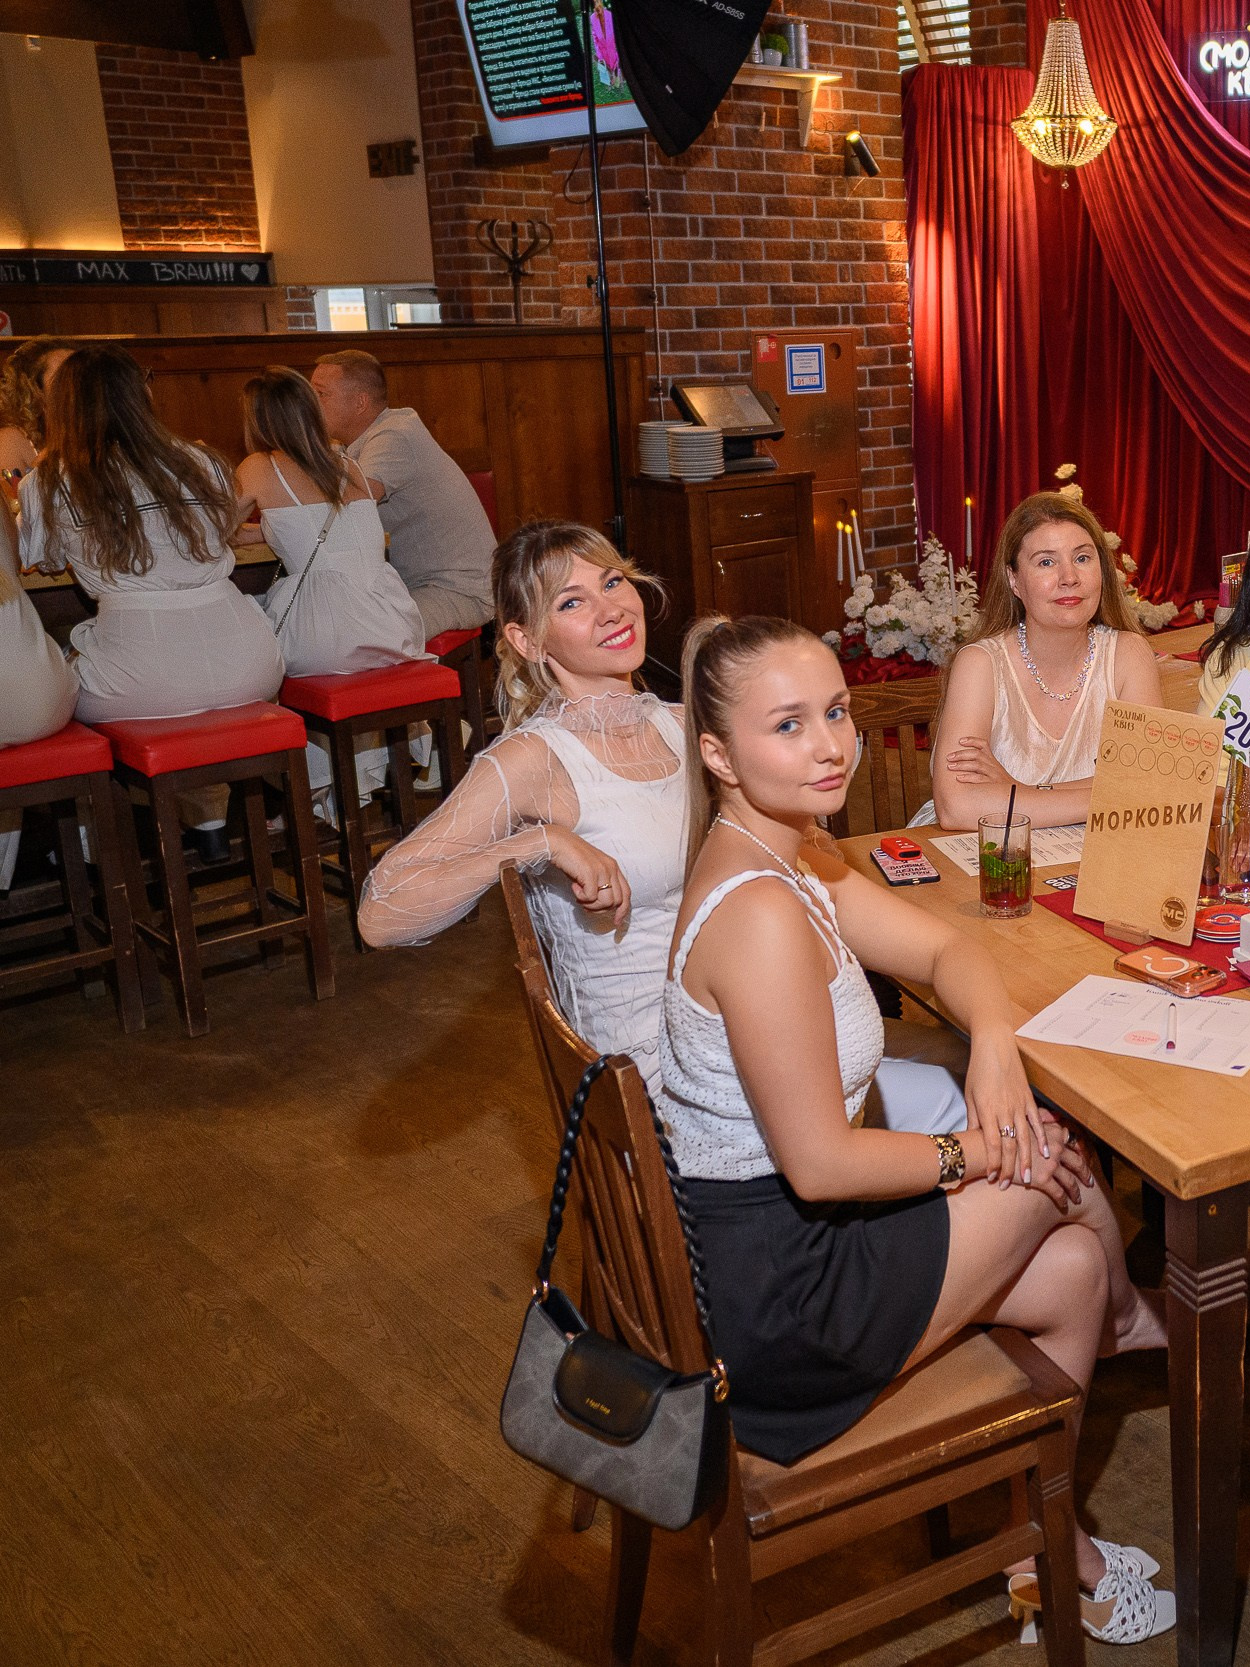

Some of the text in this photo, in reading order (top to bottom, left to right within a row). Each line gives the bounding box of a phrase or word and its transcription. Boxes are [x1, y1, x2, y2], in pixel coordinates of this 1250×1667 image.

[712, 1, 746, 20] AD-S85S
[77, 262, 130, 281] MAX
[1090, 802, 1203, 833] МОРКОВКИ
